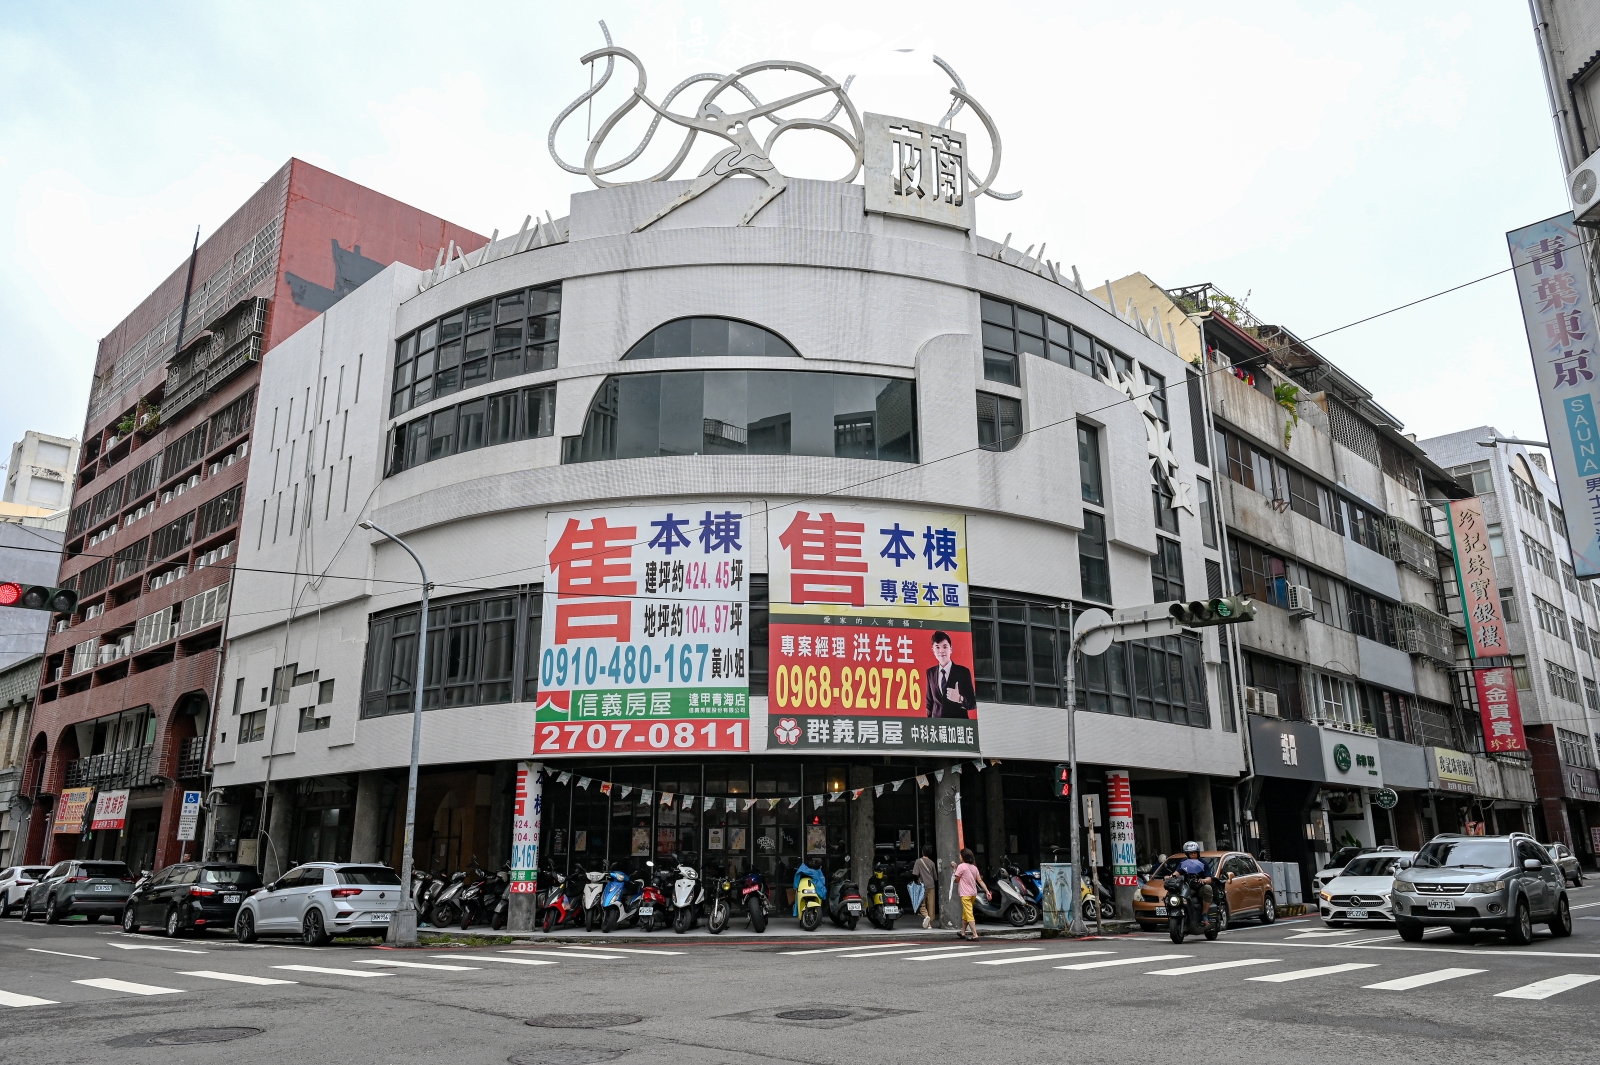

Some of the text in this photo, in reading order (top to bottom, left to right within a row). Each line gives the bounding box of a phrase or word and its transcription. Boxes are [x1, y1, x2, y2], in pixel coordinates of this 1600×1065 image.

[1525, 234, 1595, 390] 青葉東京
[1570, 399, 1599, 472] SAUNA
[648, 511, 743, 555] 本棟
[880, 523, 958, 572] 本棟
[779, 510, 868, 607] 售
[549, 517, 637, 645] 售
[880, 579, 960, 607] 專營本區
[823, 615, 925, 628] 愛家的人有福了
[542, 643, 745, 687] 0910-480-167 黃小姐
[781, 633, 915, 664] 專案經理 洪先生
[577, 692, 672, 718] 信義房屋
[688, 692, 746, 707] 逢甲青海店
[776, 665, 922, 710] 0968-829726
[1482, 671, 1514, 737] 黃金買賣
[541, 722, 744, 750] 2707-0811
[807, 719, 904, 746] 群義房屋
[911, 723, 975, 745] 中科永福加盟店
[1490, 738, 1520, 751] 珍記
